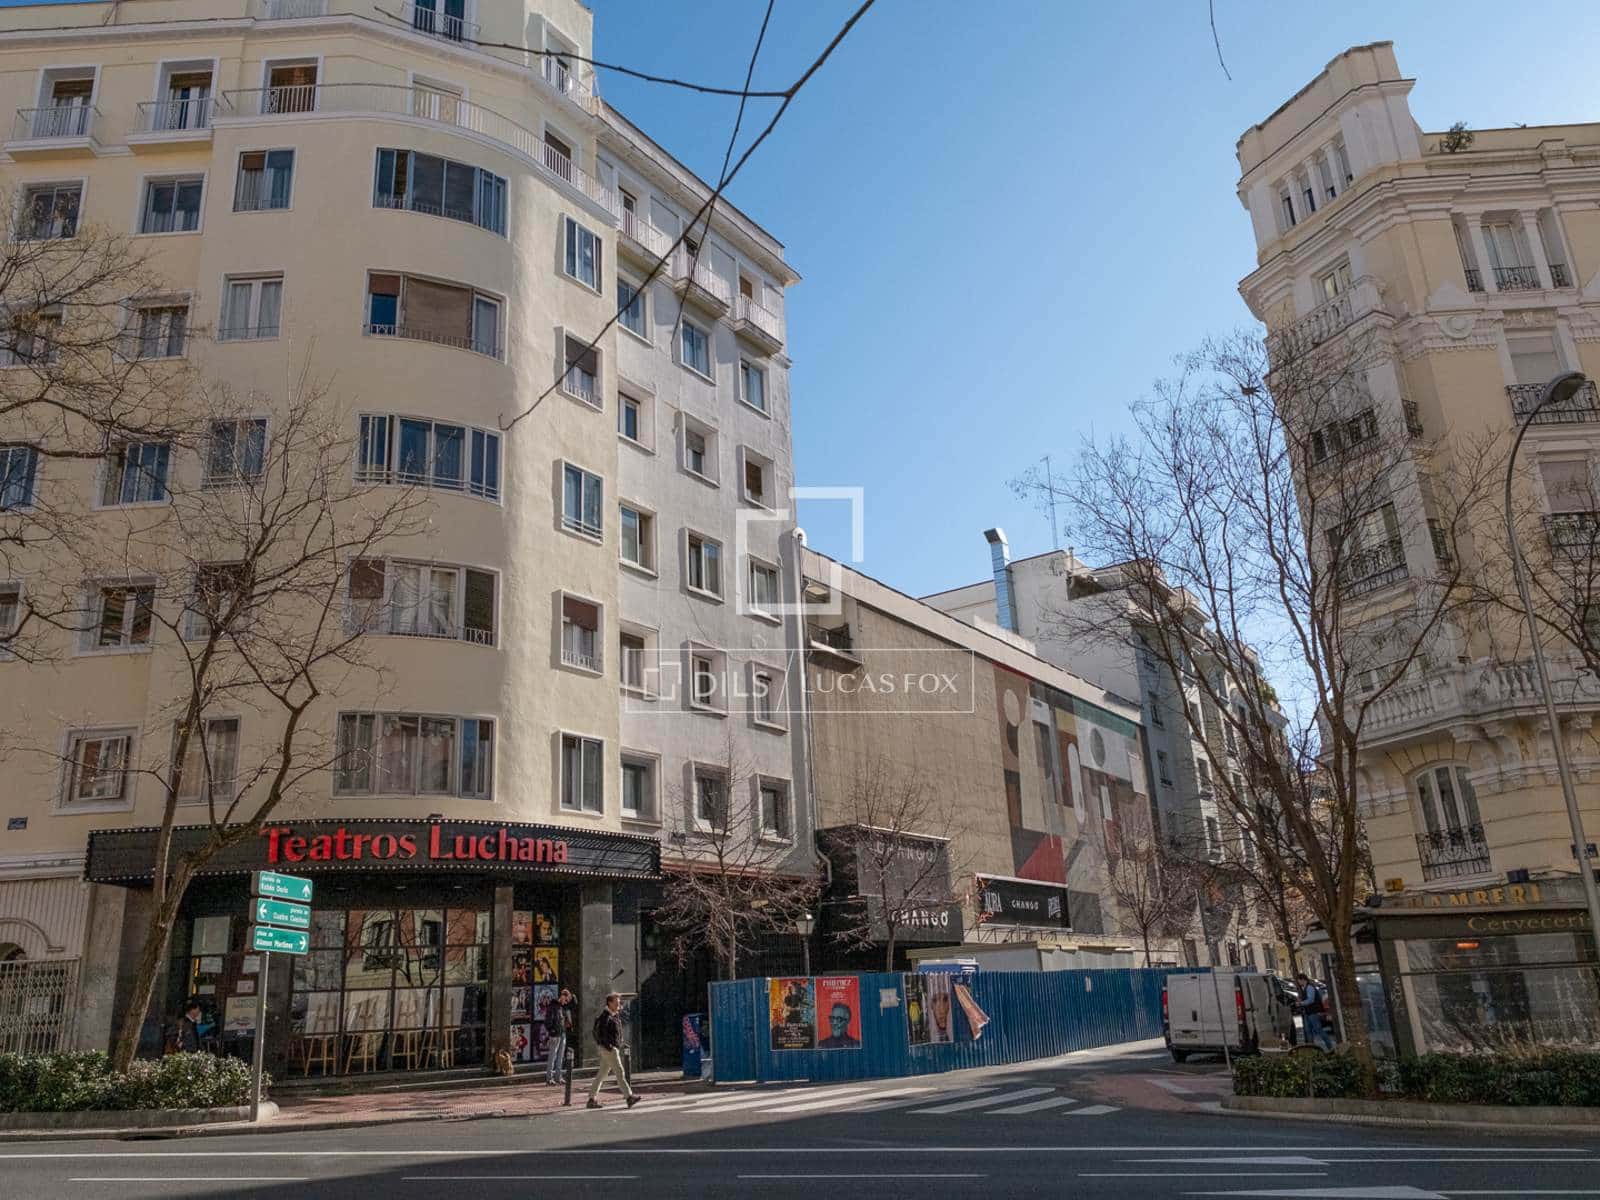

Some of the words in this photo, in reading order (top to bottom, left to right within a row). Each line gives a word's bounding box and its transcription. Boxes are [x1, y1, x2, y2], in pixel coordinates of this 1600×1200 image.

[260, 825, 417, 864] Teatros
[429, 823, 568, 864] Luchana
[1011, 898, 1040, 911] CHANGO
[1467, 911, 1591, 932] Cervecerí
